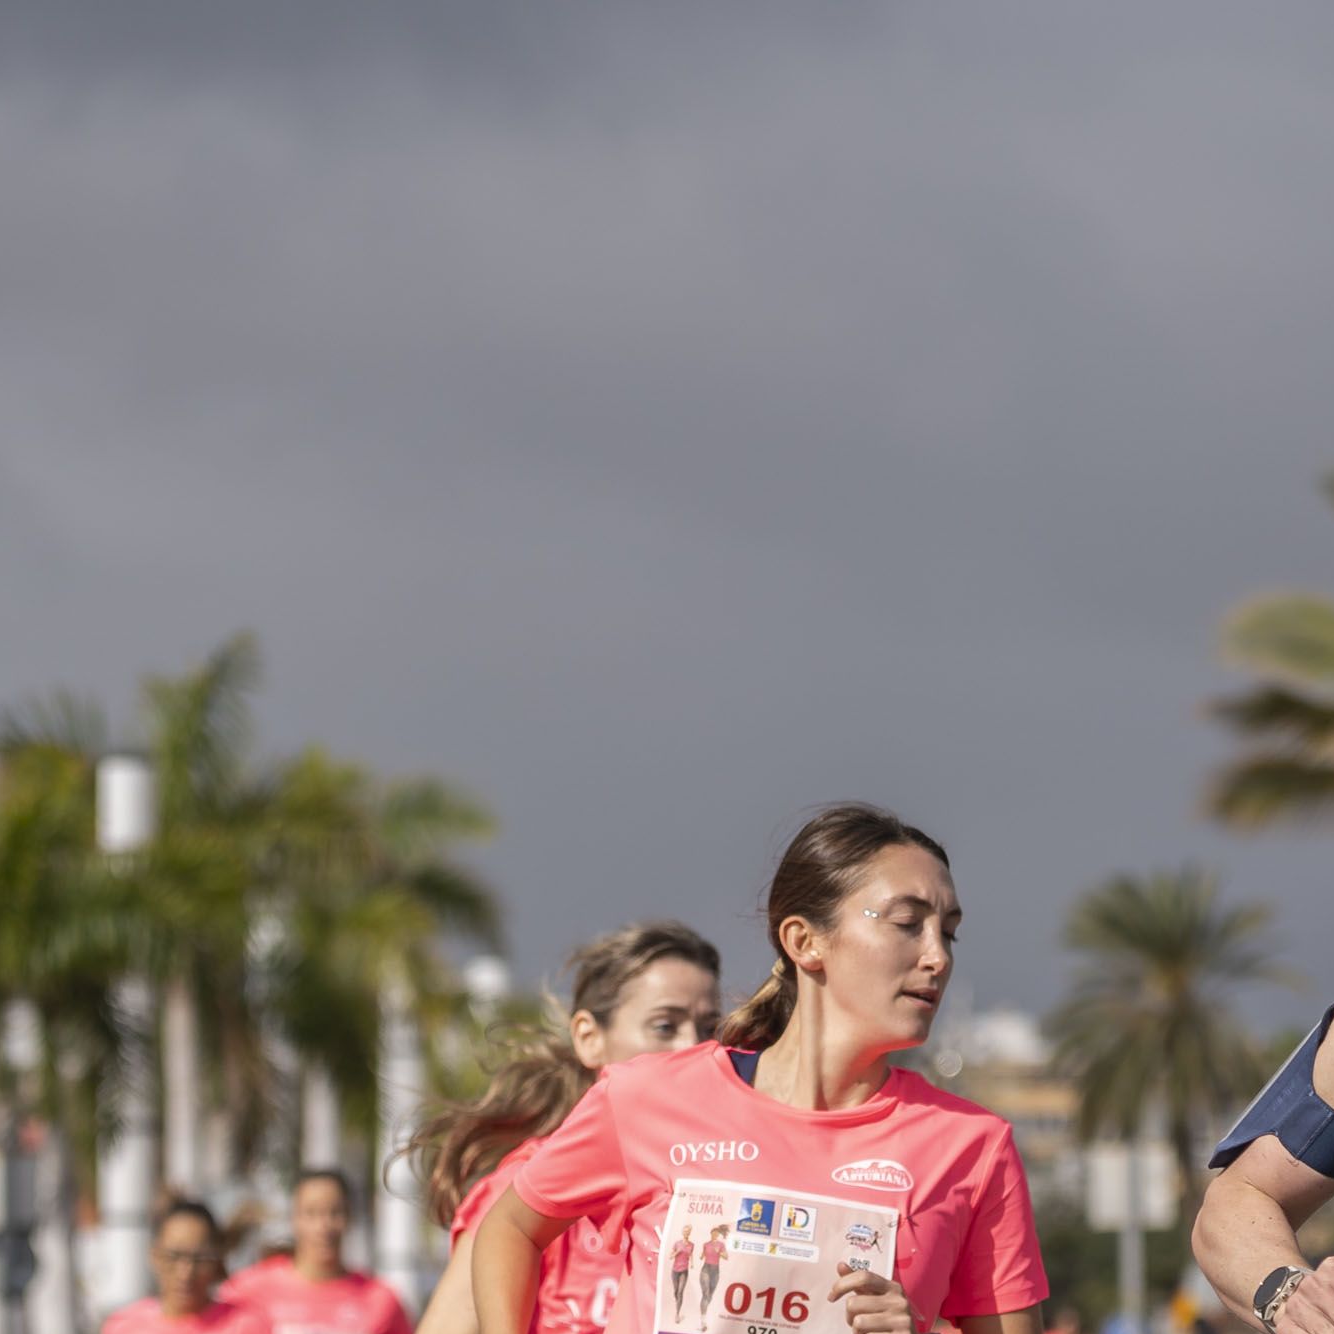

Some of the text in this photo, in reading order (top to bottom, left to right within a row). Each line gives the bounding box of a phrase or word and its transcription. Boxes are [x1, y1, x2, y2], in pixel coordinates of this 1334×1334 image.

[669, 1140, 759, 1166] OYSHO
[687, 1203, 724, 1217] SUMA
[723, 1282, 810, 1324] 016
